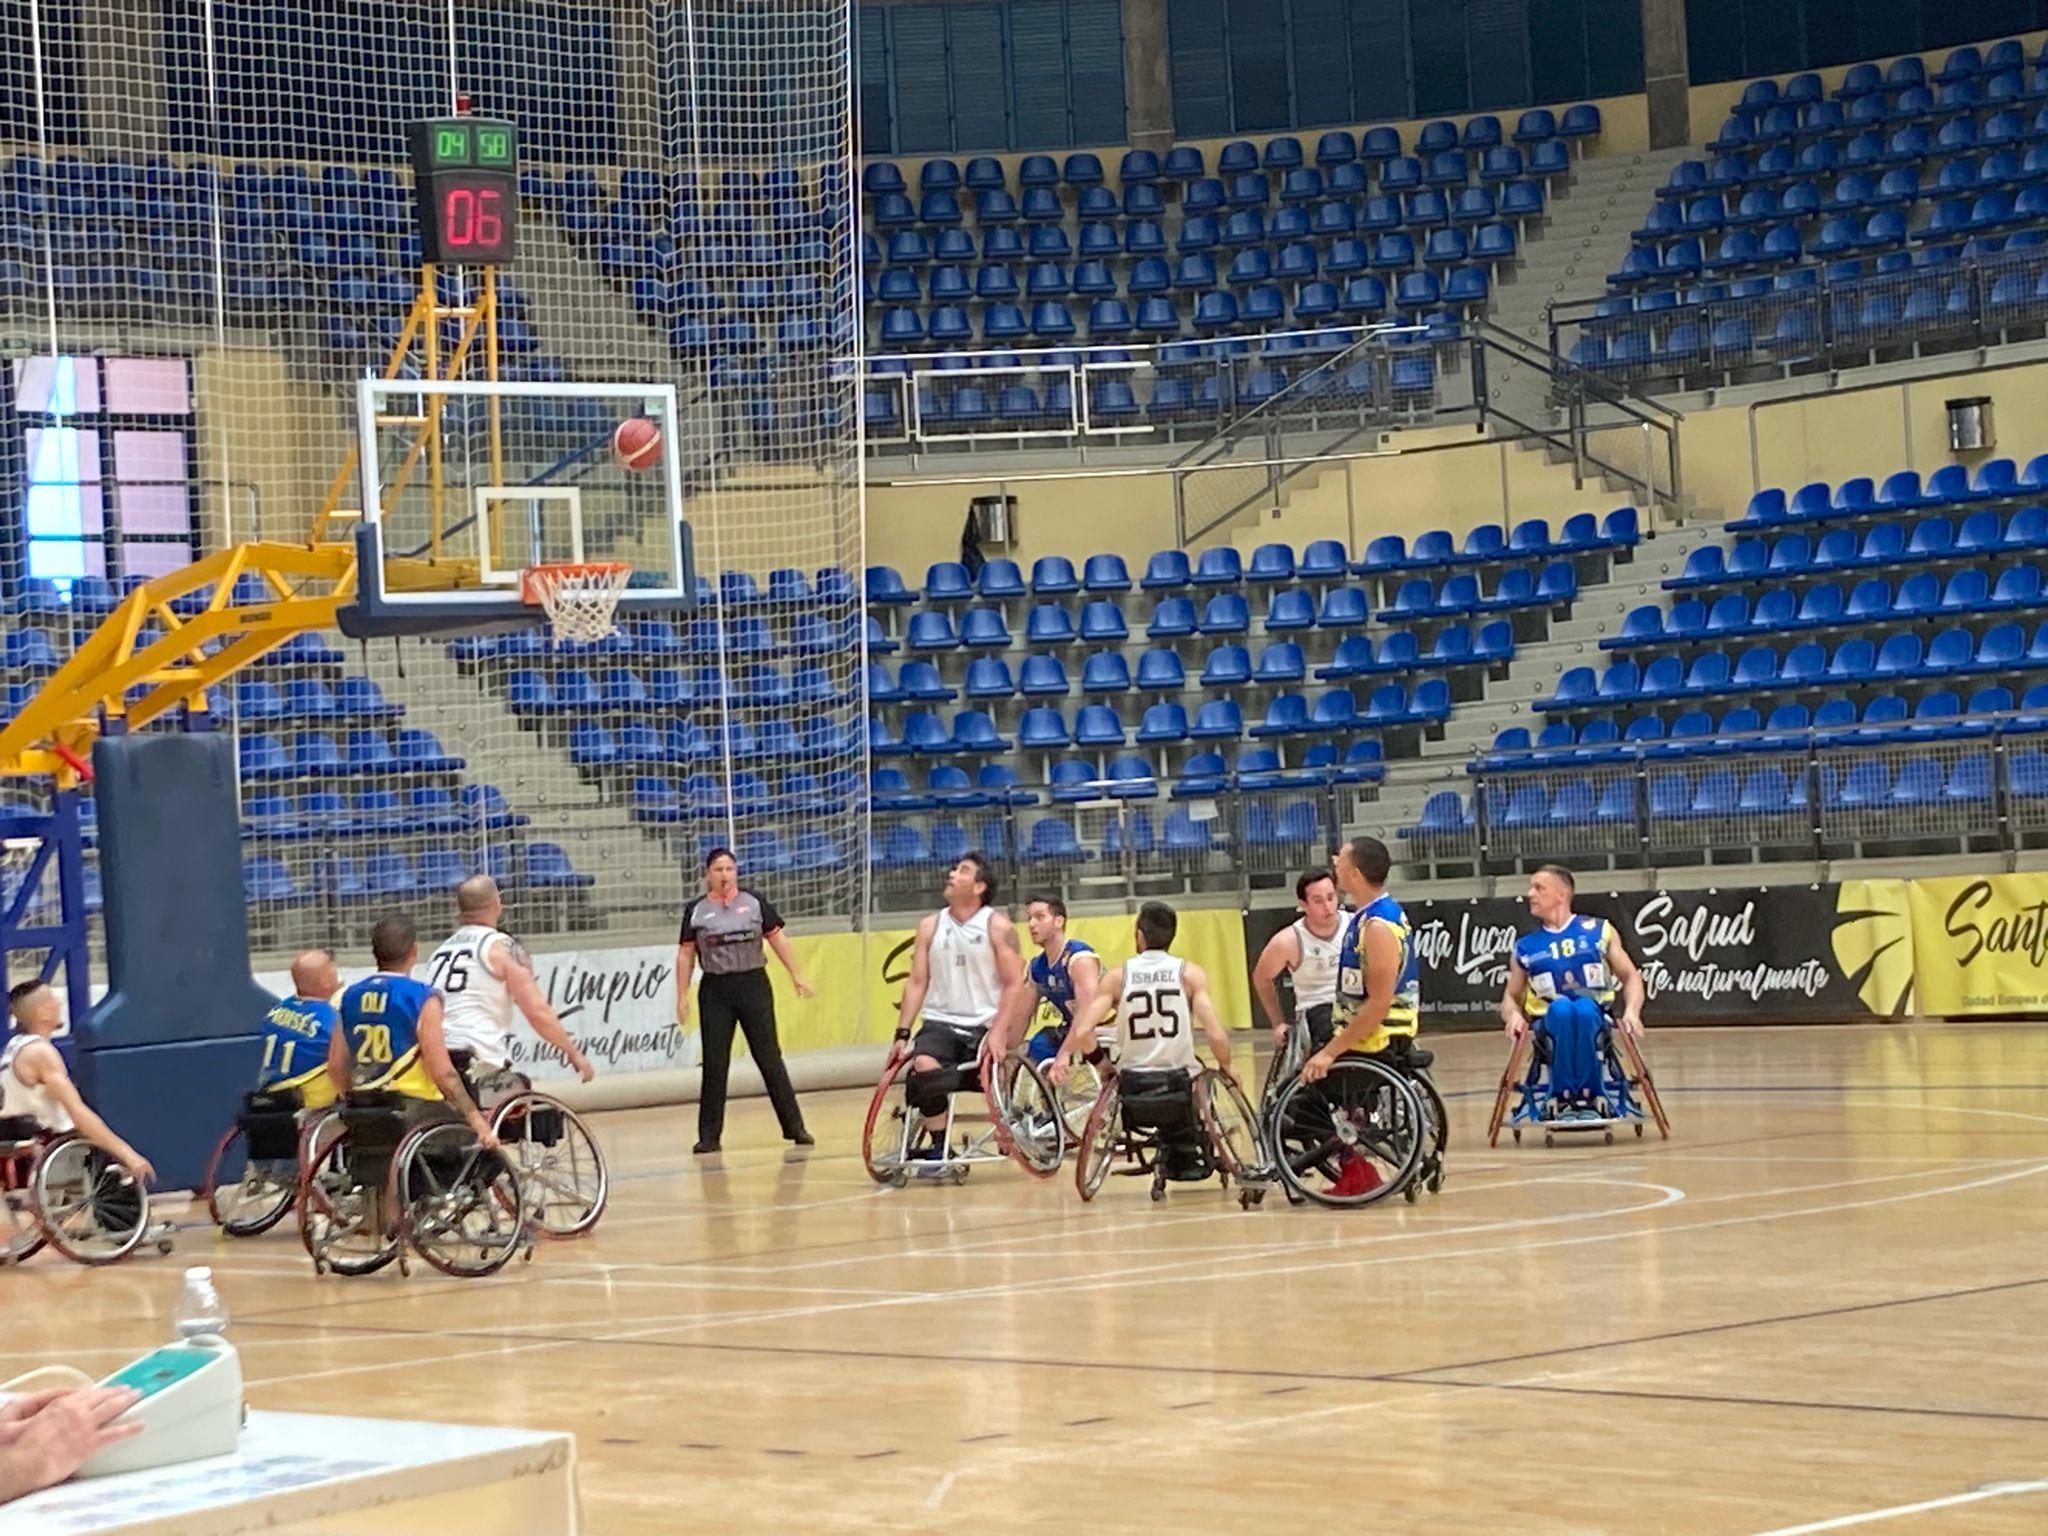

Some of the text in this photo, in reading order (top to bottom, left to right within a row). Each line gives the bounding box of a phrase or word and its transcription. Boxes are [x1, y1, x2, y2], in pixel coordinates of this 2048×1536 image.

[437, 131, 465, 157] 04
[446, 188, 502, 247] 06
[1414, 919, 1453, 969] nta
[1634, 895, 1755, 962] Salud
[1945, 880, 2048, 967] Sant
[431, 948, 473, 993] 76
[1549, 938, 1576, 960] 18
[1131, 970, 1175, 985] ISRAEL
[1126, 989, 1180, 1040] 25
[262, 1033, 297, 1074] 11
